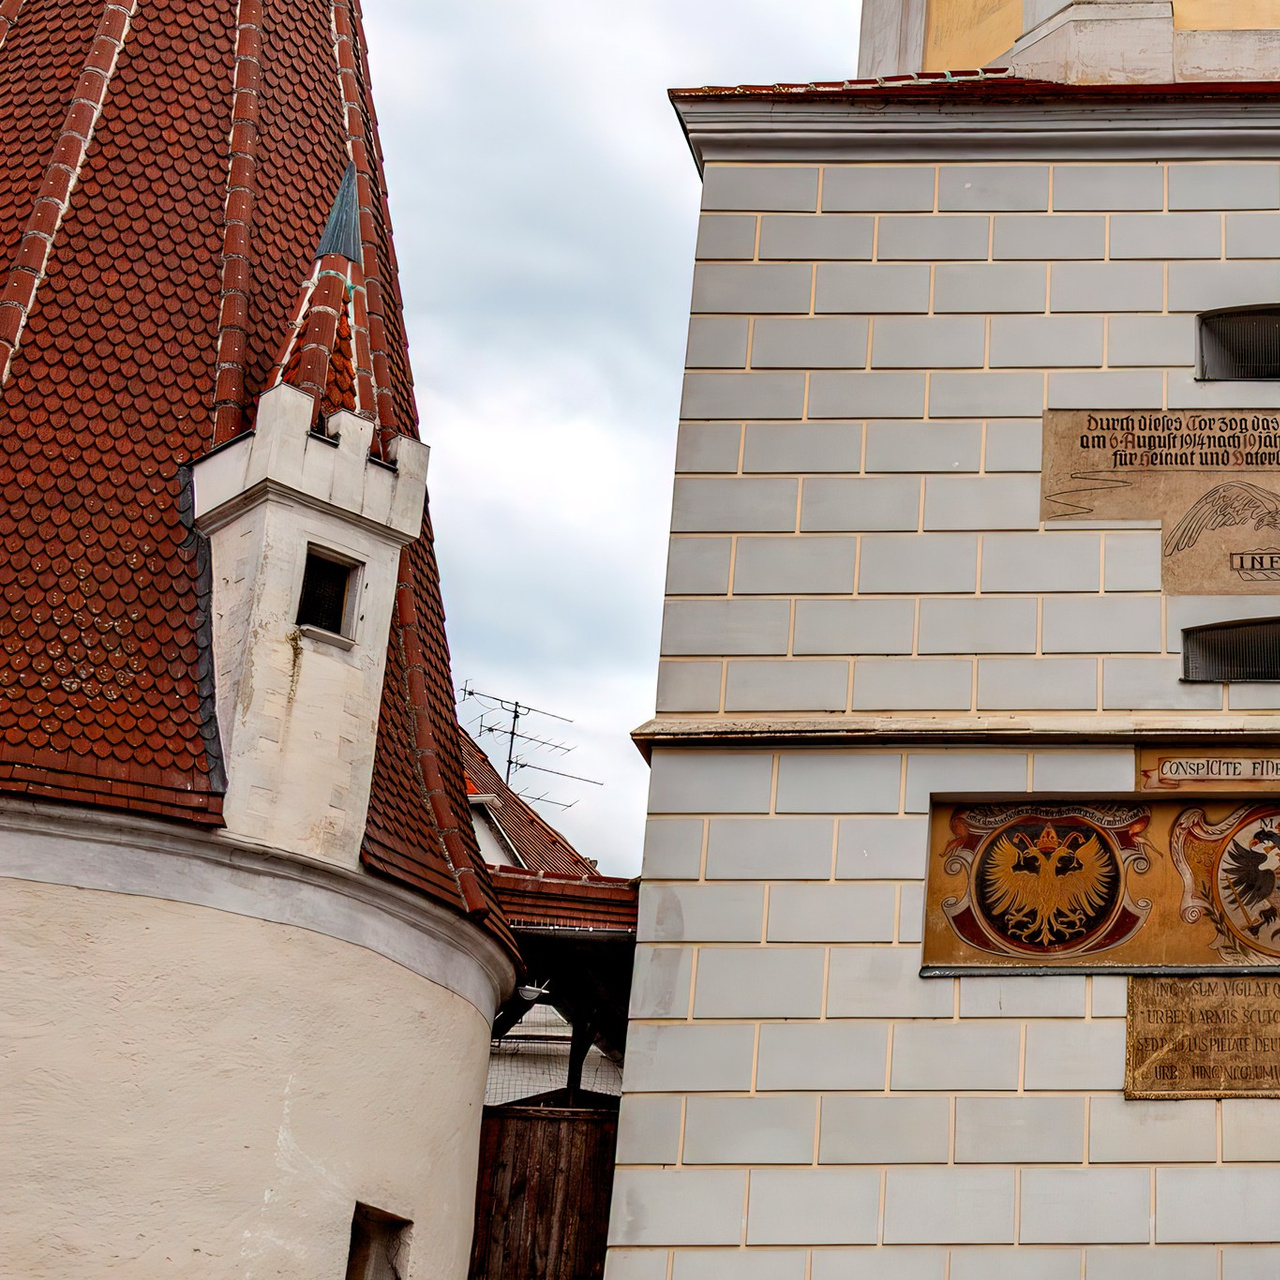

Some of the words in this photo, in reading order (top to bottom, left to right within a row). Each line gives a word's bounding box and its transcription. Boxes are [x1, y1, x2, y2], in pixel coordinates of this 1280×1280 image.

[1087, 414, 1135, 433] Durch
[1138, 414, 1183, 432] dieses
[1186, 415, 1216, 431] Tor
[1218, 416, 1250, 434] zog
[1252, 415, 1279, 431] das
[1080, 435, 1107, 449] am
[1179, 433, 1206, 450] 1914
[1206, 433, 1241, 450] nach
[1112, 450, 1138, 468] für
[1199, 450, 1230, 466] und
[1239, 555, 1280, 569] INF
[1161, 760, 1242, 776] CONSPICITE
[1259, 818, 1275, 829] M
[1223, 981, 1271, 997] VIGILAT
[1197, 1009, 1239, 1025] ARMIS
[1209, 1037, 1250, 1052] PIETATE
